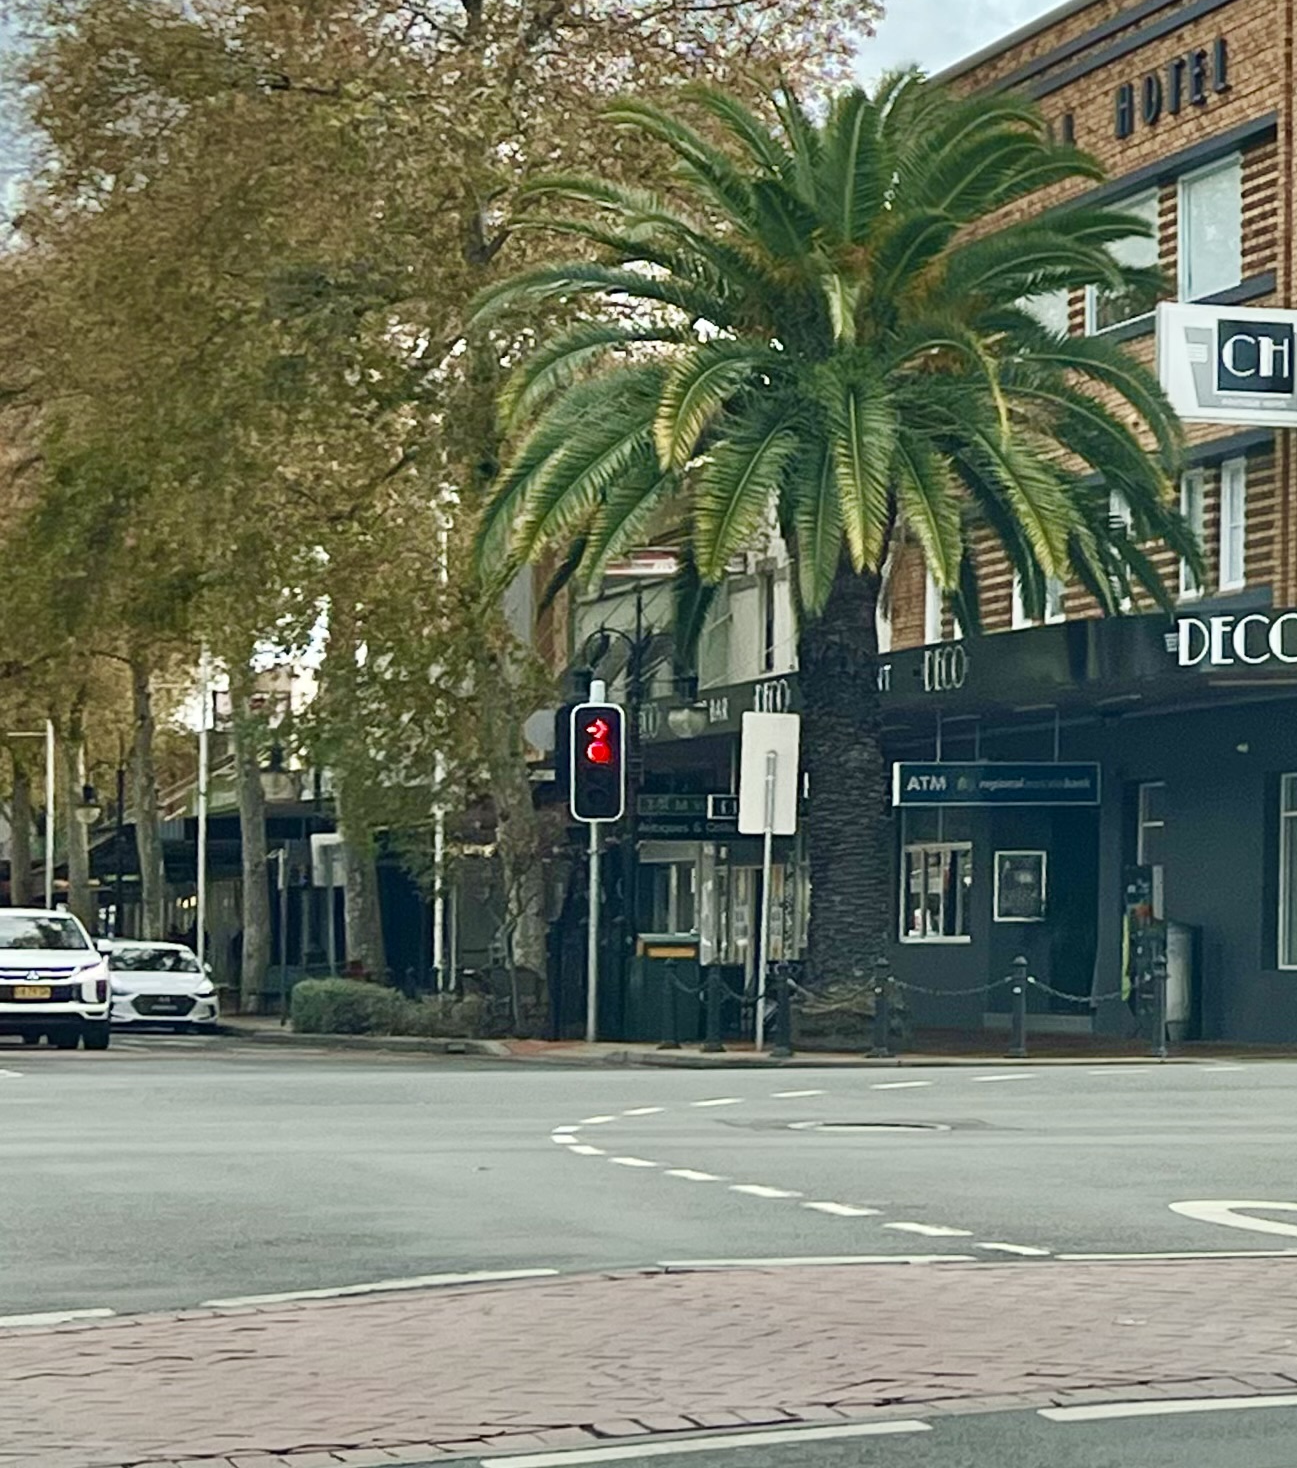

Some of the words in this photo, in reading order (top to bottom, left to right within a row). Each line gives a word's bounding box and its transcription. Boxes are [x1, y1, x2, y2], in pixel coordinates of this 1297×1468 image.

[1114, 35, 1232, 139] HOTEL
[1221, 333, 1290, 379] CH
[923, 644, 967, 692] DECO
[906, 775, 948, 792] ATM
